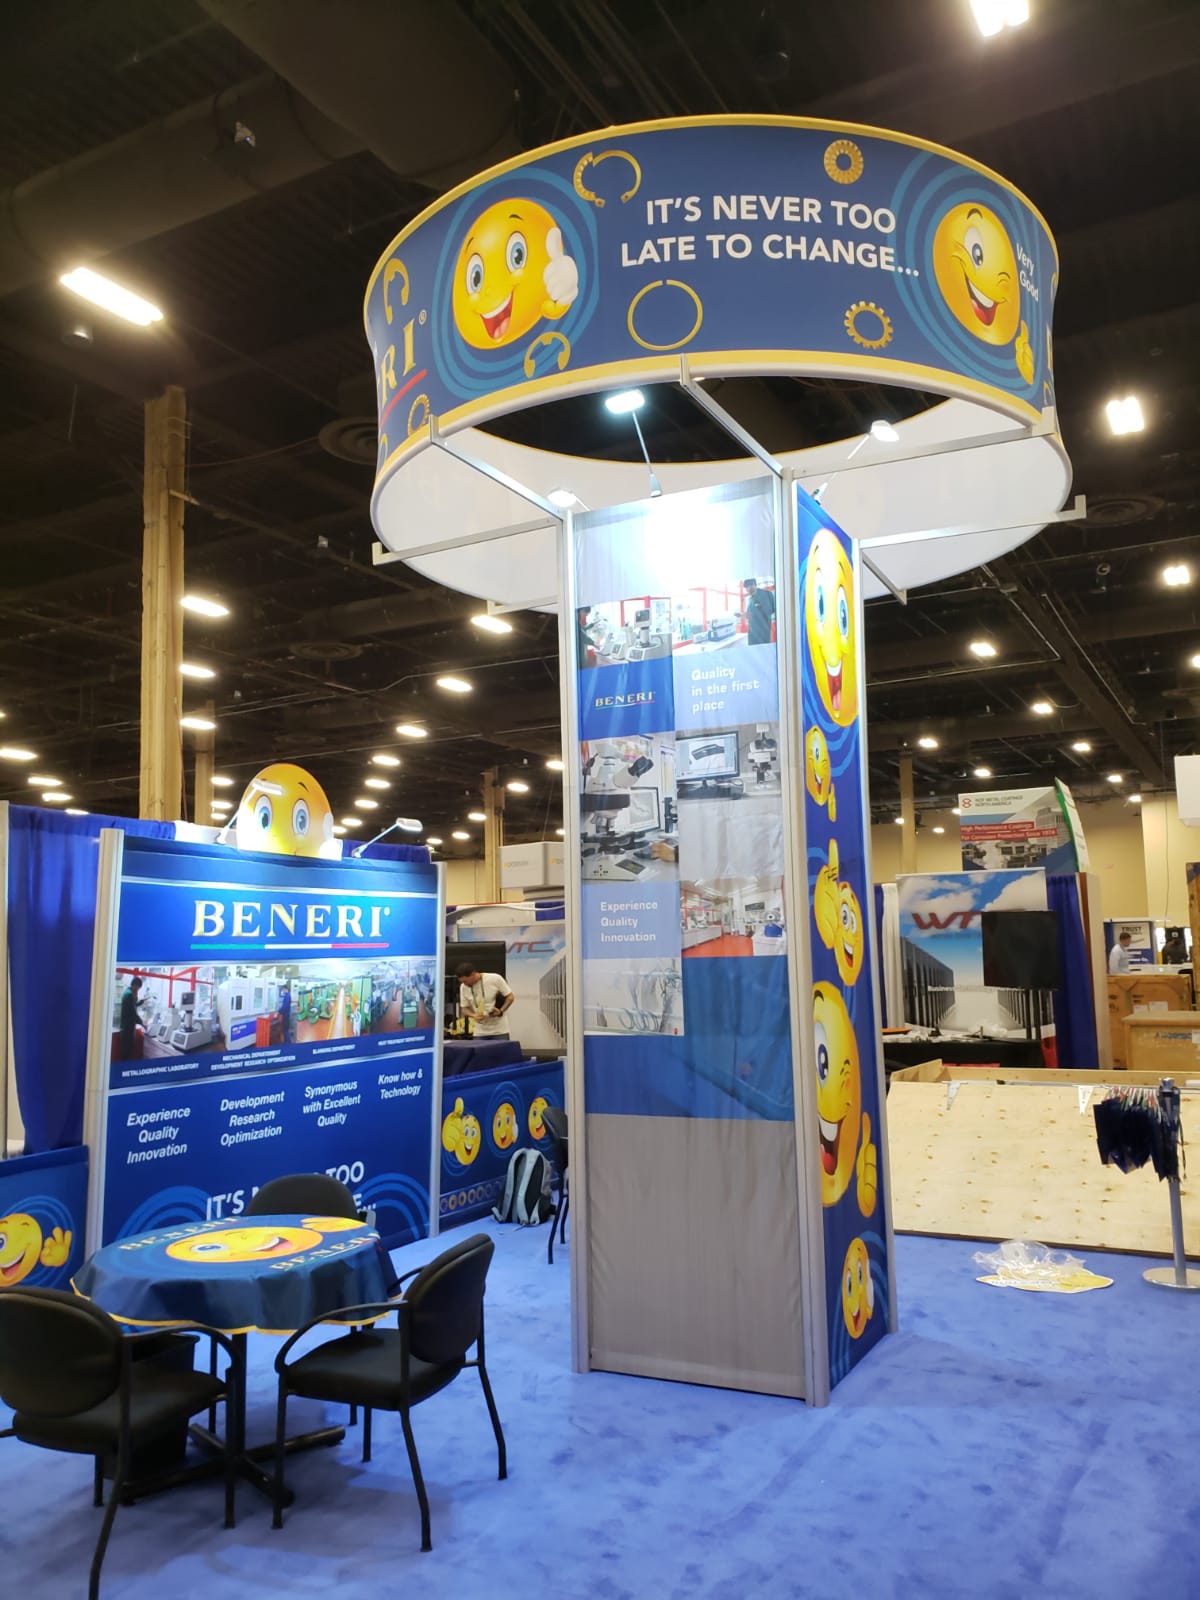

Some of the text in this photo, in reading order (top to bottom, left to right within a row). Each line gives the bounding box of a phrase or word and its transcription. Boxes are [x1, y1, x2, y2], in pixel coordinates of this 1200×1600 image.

[647, 195, 896, 233] IT'S NEVER TOO
[621, 234, 919, 277] LATE TO CHANGE...
[1016, 243, 1035, 276] Very
[1019, 271, 1039, 302] Good
[691, 666, 735, 682] Quality
[691, 679, 760, 697] in the first
[595, 691, 654, 708] BENERI
[692, 701, 725, 716] place
[600, 900, 658, 913] Experience
[192, 900, 390, 938] BENERI
[600, 917, 638, 928] Quality
[912, 911, 982, 929] WT
[600, 932, 656, 943] Innovation
[168, 1062, 199, 1073] LABORATORY
[378, 1068, 423, 1085] Know how &
[304, 1081, 358, 1099] Synonymous
[380, 1085, 421, 1099] Technology
[220, 1091, 285, 1111] Development
[302, 1094, 361, 1114] with Excellent
[127, 1107, 191, 1127] Experience
[229, 1109, 276, 1127] Research
[317, 1112, 347, 1127] Quality
[138, 1126, 180, 1143] Quality
[220, 1125, 282, 1147] Optimization
[127, 1143, 188, 1164] Innovation
[206, 1190, 245, 1221] IT'S
